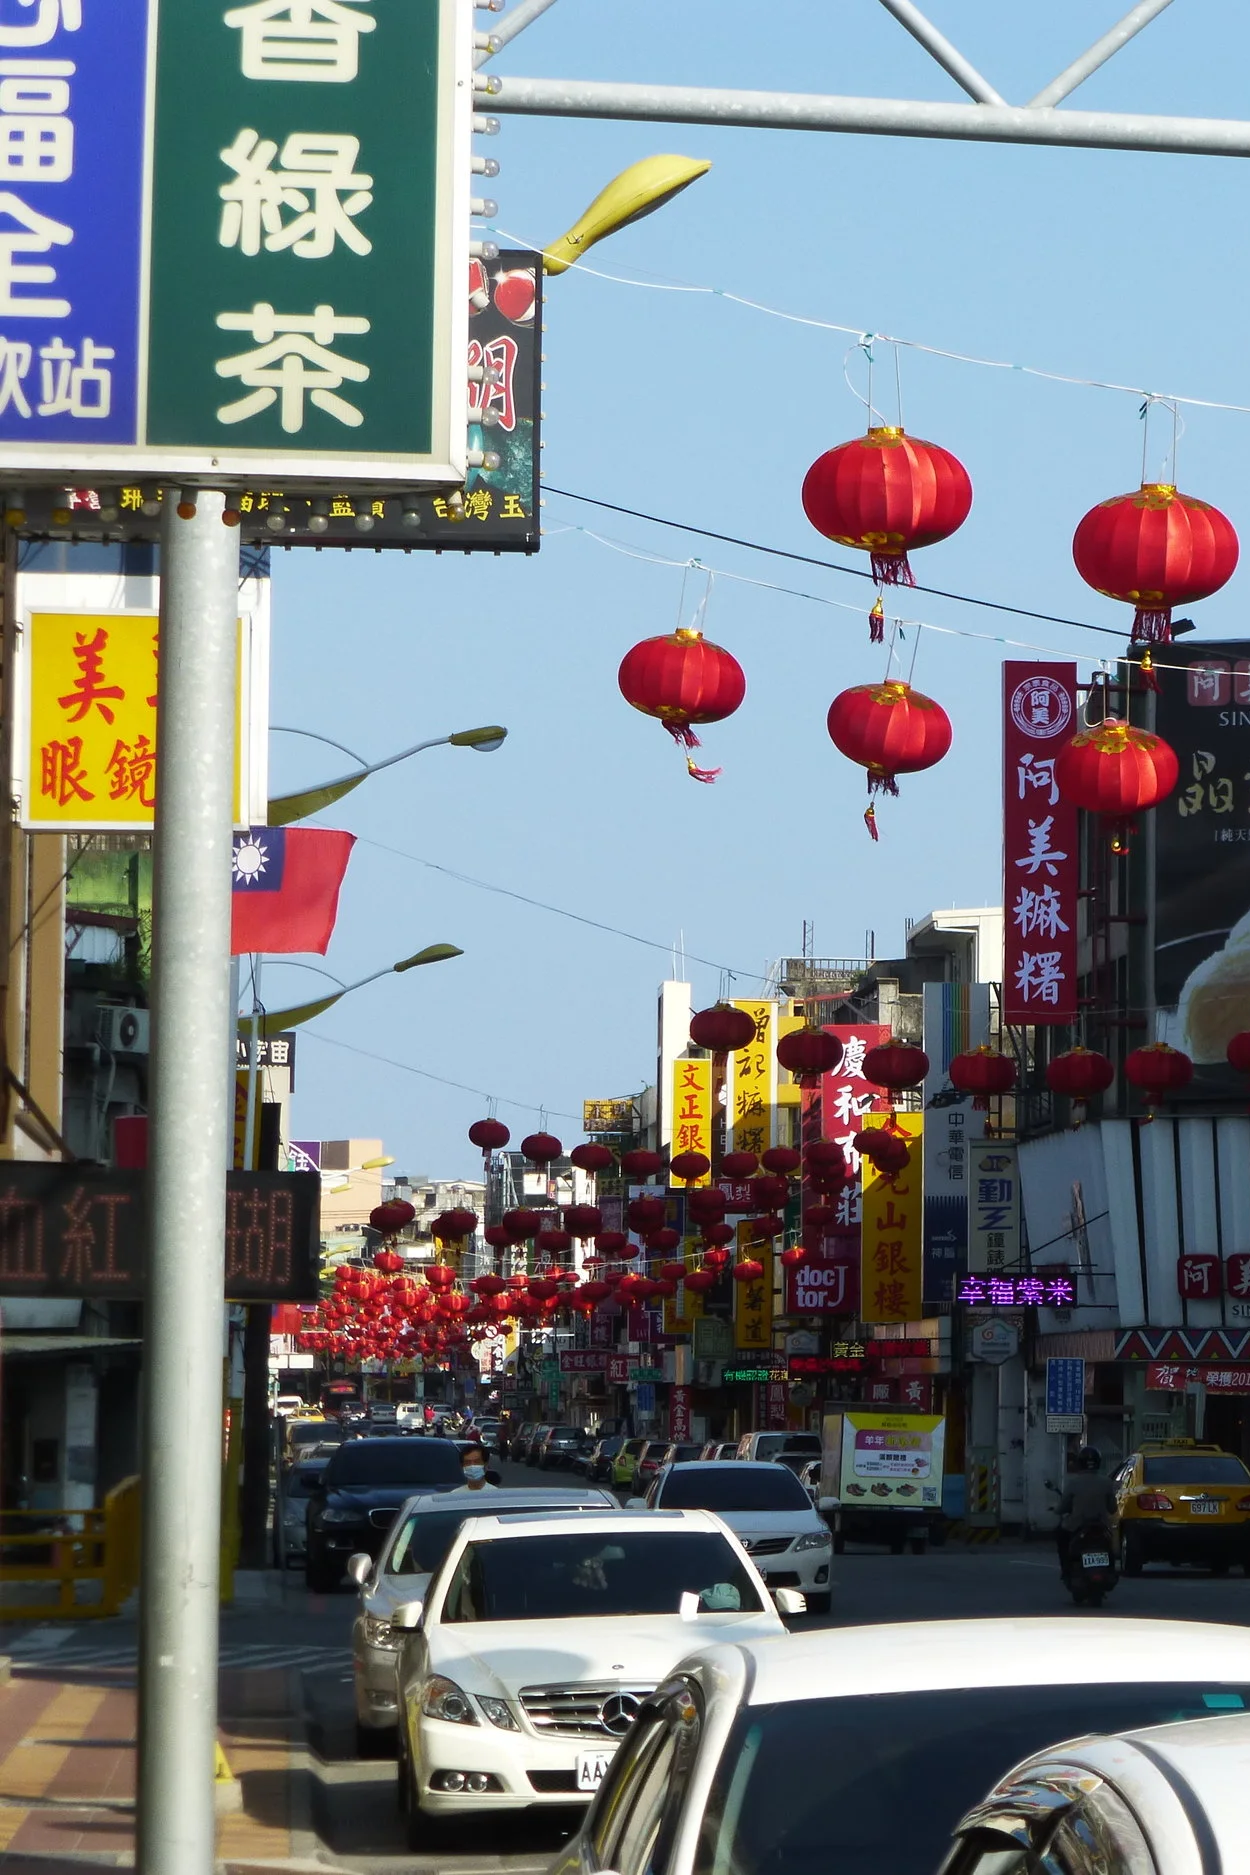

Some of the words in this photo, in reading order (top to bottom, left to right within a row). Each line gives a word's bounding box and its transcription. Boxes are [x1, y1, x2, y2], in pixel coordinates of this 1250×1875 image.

[676, 1063, 707, 1183] 文正銀
[948, 1112, 965, 1181] 中華電信
[581, 1760, 610, 1783] AA
